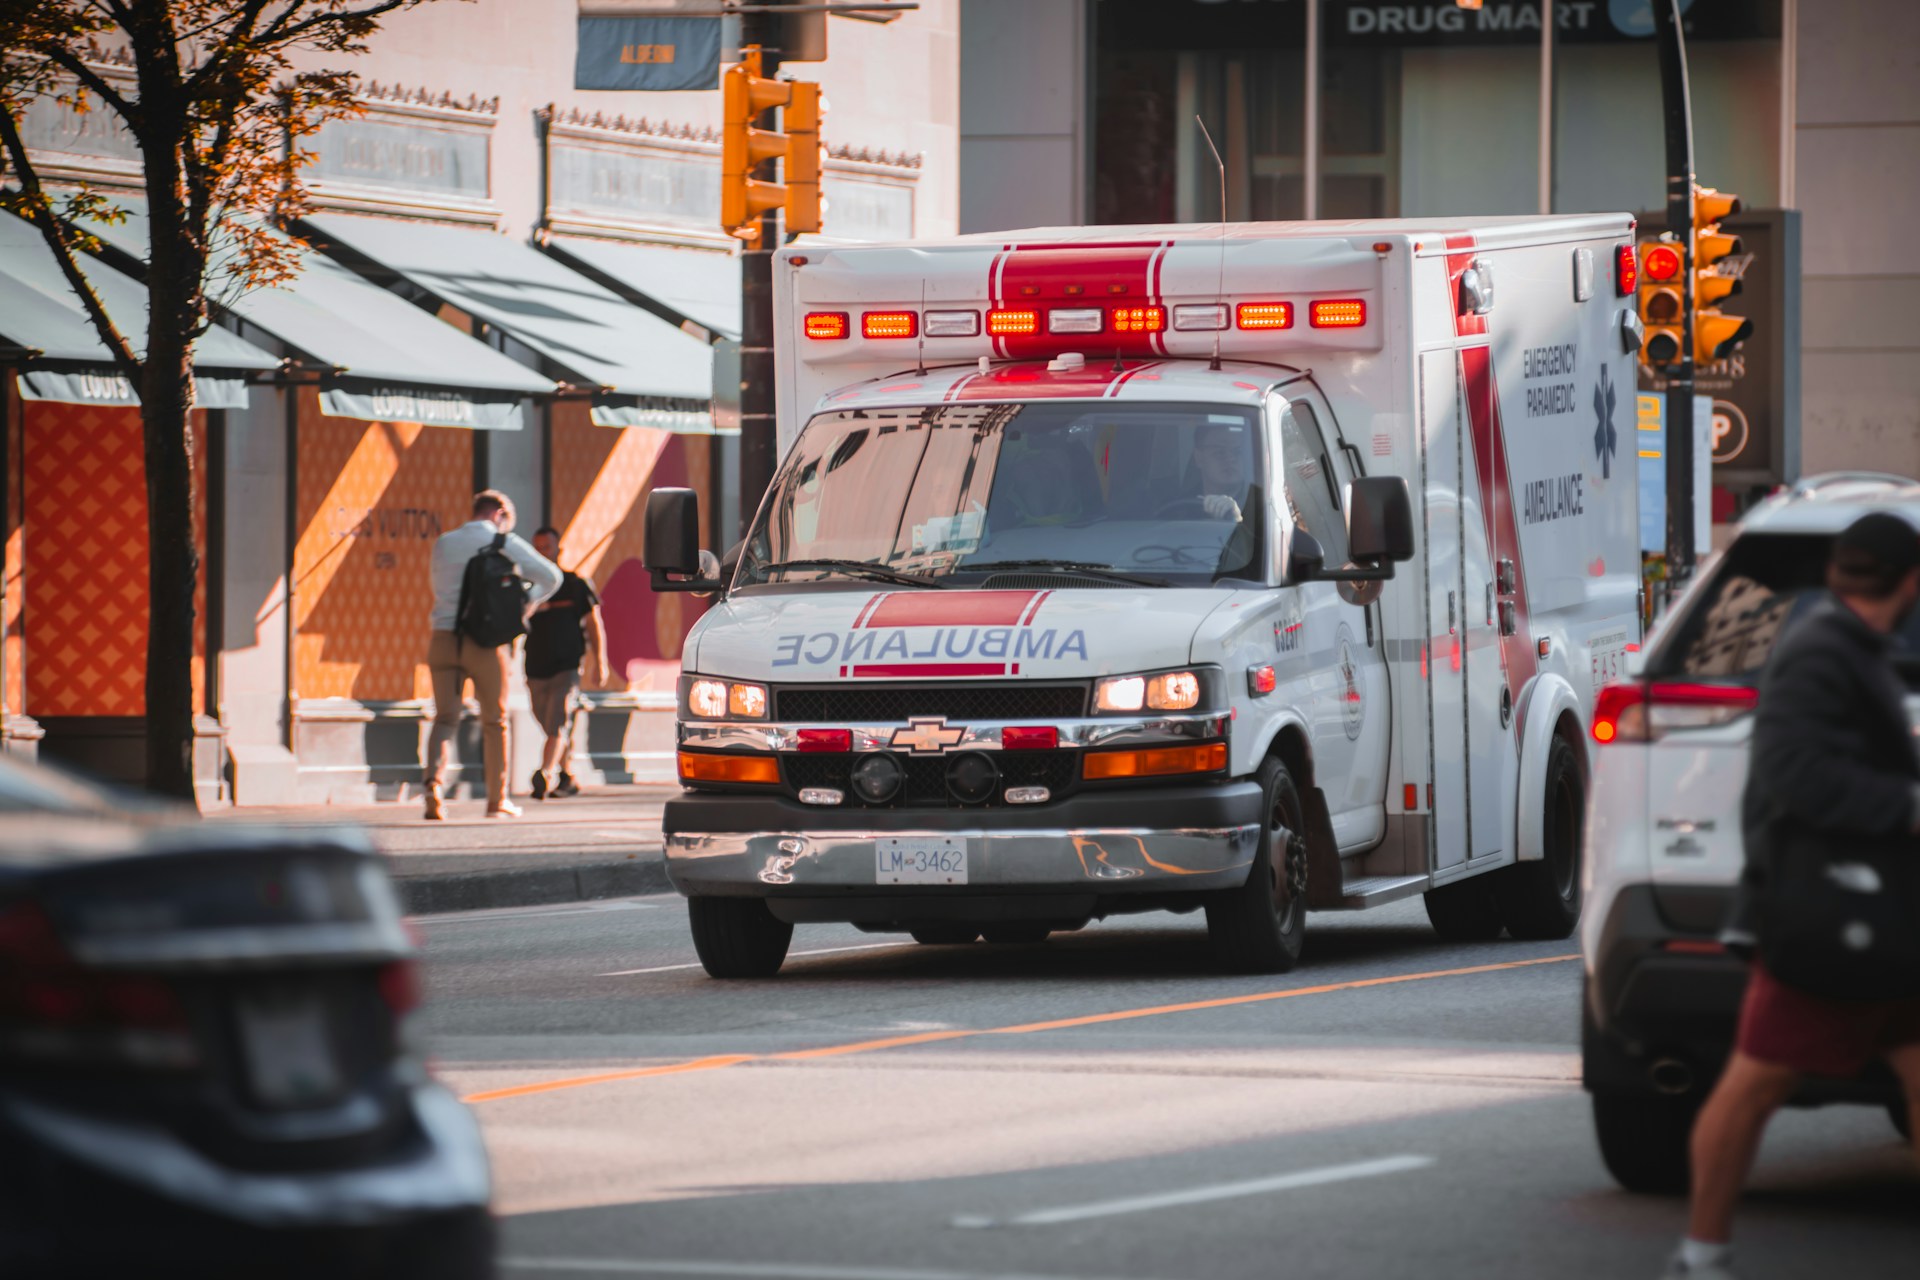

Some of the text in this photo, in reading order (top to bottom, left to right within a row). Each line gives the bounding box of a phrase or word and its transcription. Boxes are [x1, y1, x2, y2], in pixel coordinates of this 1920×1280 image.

[1347, 1, 1596, 33] DRUG MART
[1523, 343, 1577, 379] EMERGENCY
[80, 368, 130, 400] LOUIS
[1527, 382, 1576, 418] PARAMEDIC
[372, 387, 416, 418] LOUIS
[1711, 413, 1731, 449] P
[1524, 473, 1583, 525] AMBULANCE
[1592, 651, 1627, 684] FAST
